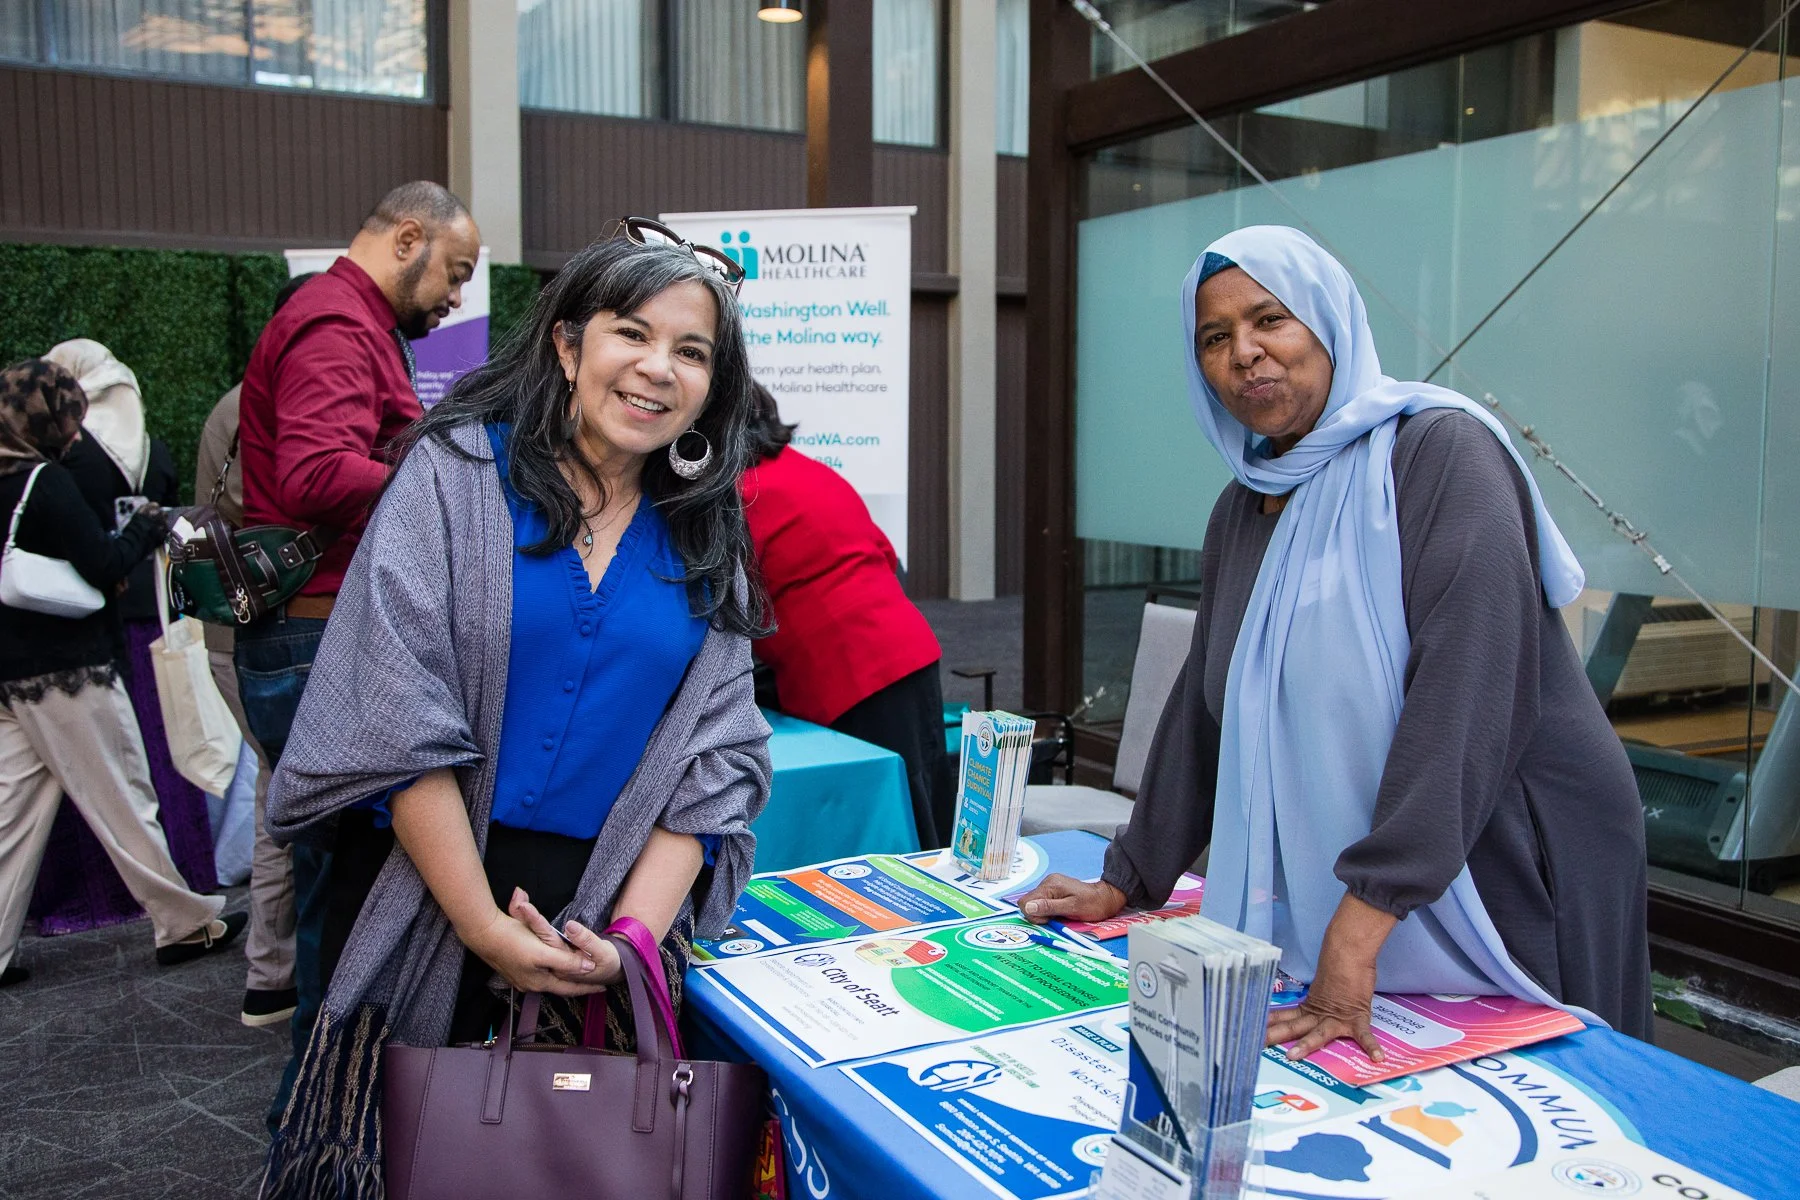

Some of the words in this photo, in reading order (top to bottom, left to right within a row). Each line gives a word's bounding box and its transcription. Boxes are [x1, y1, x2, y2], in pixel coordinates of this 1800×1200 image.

[762, 243, 866, 264] MOLINA
[762, 265, 866, 279] HEALTHCARE
[847, 300, 890, 316] Well.
[777, 327, 836, 344] Molina
[842, 331, 883, 348] way.
[778, 366, 805, 377] your
[807, 363, 849, 374] health
[772, 382, 812, 393] Molina
[815, 380, 888, 393] Healthcare
[969, 757, 993, 777] CLIMATE
[967, 768, 991, 788] CHANGE
[966, 778, 993, 801] SURVIVAL
[822, 968, 851, 984] City
[1008, 953, 1032, 964] RIGHT
[1040, 970, 1063, 981] LEGAL
[1062, 982, 1099, 1000] COUNSEL
[843, 983, 870, 994] of
[1034, 978, 1089, 1006] PROCEEDINGS
[856, 990, 901, 1017] Seatt
[1132, 1001, 1157, 1021] Somali
[1158, 1012, 1200, 1045] Community
[1373, 1004, 1425, 1029] BROCHURE
[1075, 1026, 1096, 1041] MAKE
[1098, 1040, 1119, 1051] PLAN
[1133, 1016, 1163, 1039] Services
[1164, 1032, 1173, 1043] of
[1051, 1037, 1116, 1074] Disaster
